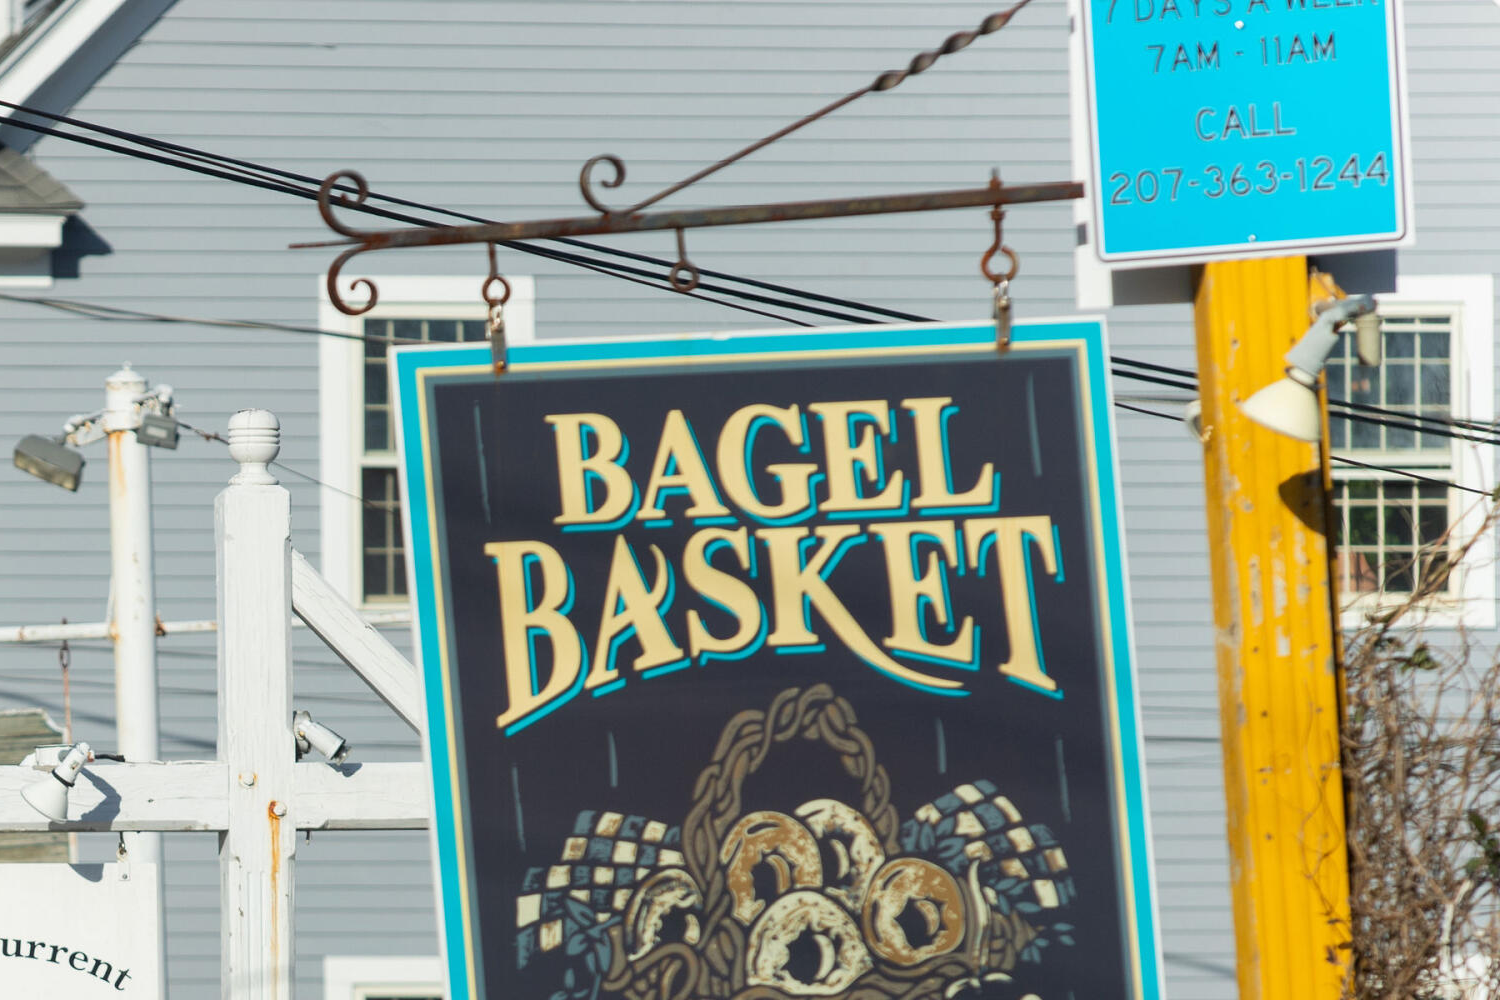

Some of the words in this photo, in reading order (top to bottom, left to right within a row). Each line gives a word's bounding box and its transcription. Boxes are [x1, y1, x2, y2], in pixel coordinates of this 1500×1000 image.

[1146, 42, 1221, 73] 7AM
[1260, 32, 1337, 66] 11AM
[1194, 102, 1297, 141] CALL
[1108, 152, 1390, 206] 207-363-1244
[544, 396, 1000, 532] BAGEL
[484, 515, 1064, 736] BASKET
